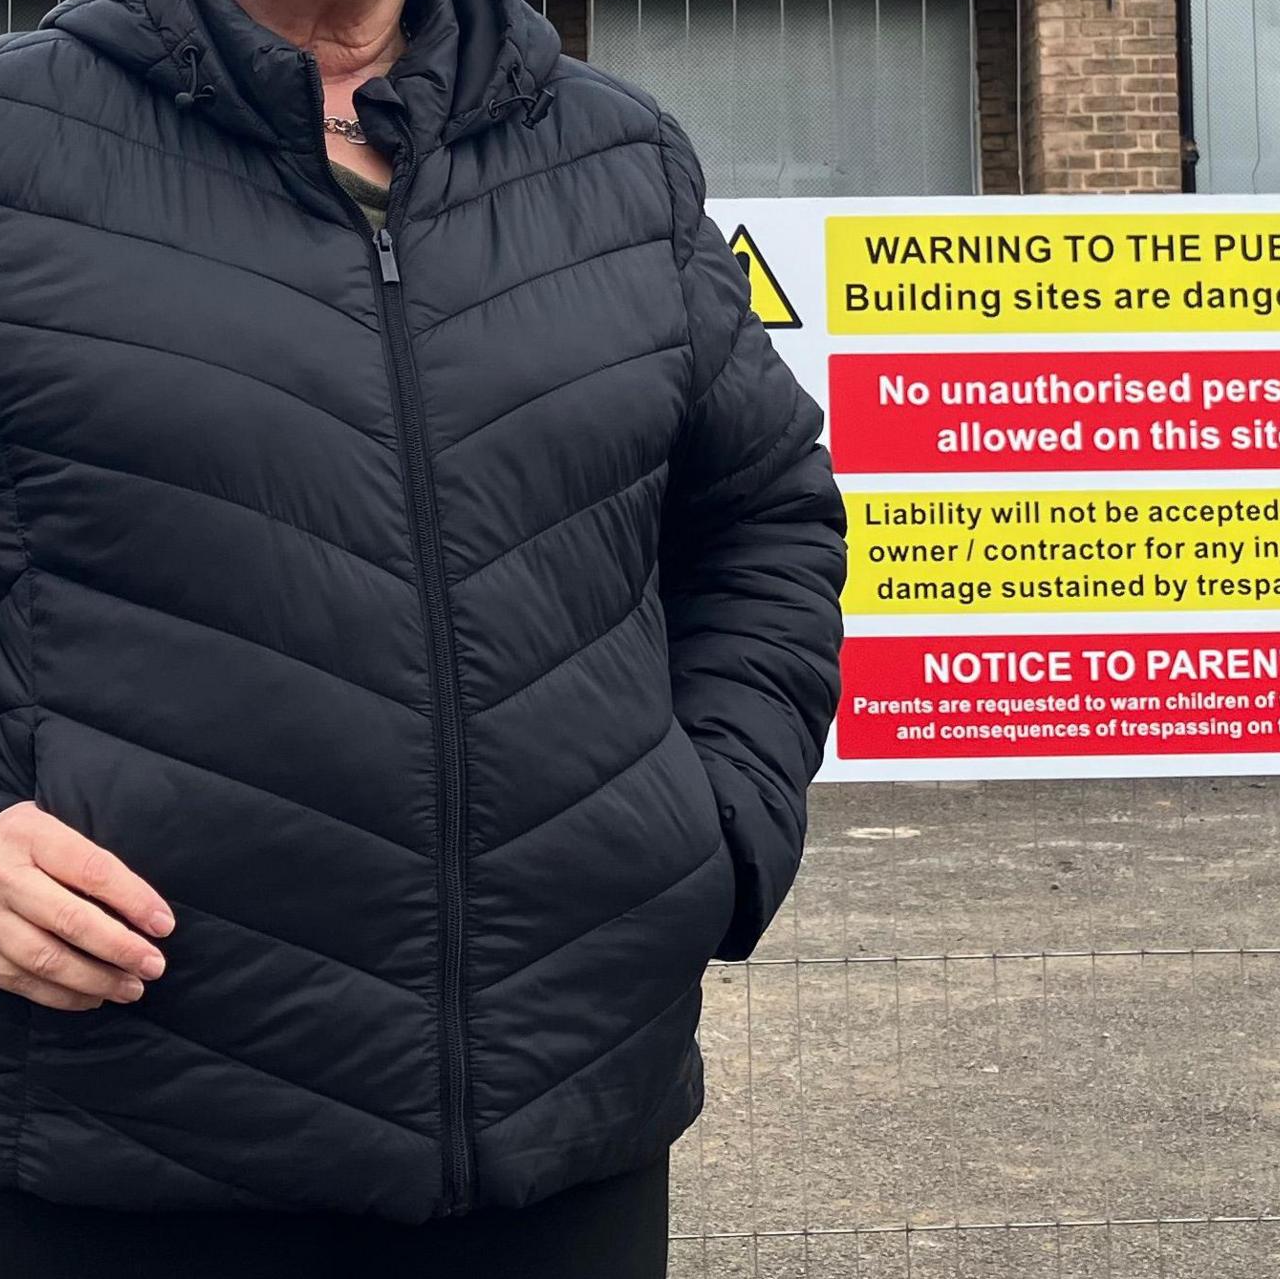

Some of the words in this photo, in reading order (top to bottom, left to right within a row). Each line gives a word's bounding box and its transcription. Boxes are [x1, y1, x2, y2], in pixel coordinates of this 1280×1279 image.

[865, 235, 1051, 265] WARNING
[1063, 234, 1114, 263] TO
[1126, 234, 1202, 263] THE
[845, 282, 1001, 318] Building
[1014, 282, 1102, 310] sites
[1114, 288, 1171, 309] are
[879, 375, 930, 406] No
[941, 372, 1191, 405] unauthorised
[937, 420, 1083, 453] allowed
[1093, 427, 1140, 451] on
[1149, 419, 1221, 451] this
[865, 502, 982, 531] Liability
[991, 501, 1039, 524] will
[1050, 502, 1097, 523] not
[1106, 500, 1139, 523] be
[1148, 499, 1279, 527] accepted
[868, 544, 959, 563] owner
[966, 538, 974, 561] /
[984, 538, 1137, 562] contractor
[1144, 536, 1186, 560] for
[1194, 541, 1245, 565] any
[877, 577, 992, 605] damage
[1001, 574, 1144, 599] sustained
[1154, 574, 1188, 602] by
[924, 651, 1073, 684] NOTICE
[1081, 650, 1136, 682] TO
[853, 697, 934, 715] Parents
[938, 699, 972, 714] are
[976, 694, 1080, 716] requested
[1084, 695, 1106, 711] to
[1110, 696, 1161, 711] warn
[1165, 692, 1250, 710] children
[1254, 690, 1276, 709] of
[896, 722, 935, 740] and
[940, 723, 1091, 742] consequences
[1095, 718, 1117, 737] of
[1120, 717, 1243, 739] trespassing
[1247, 720, 1273, 735] on
